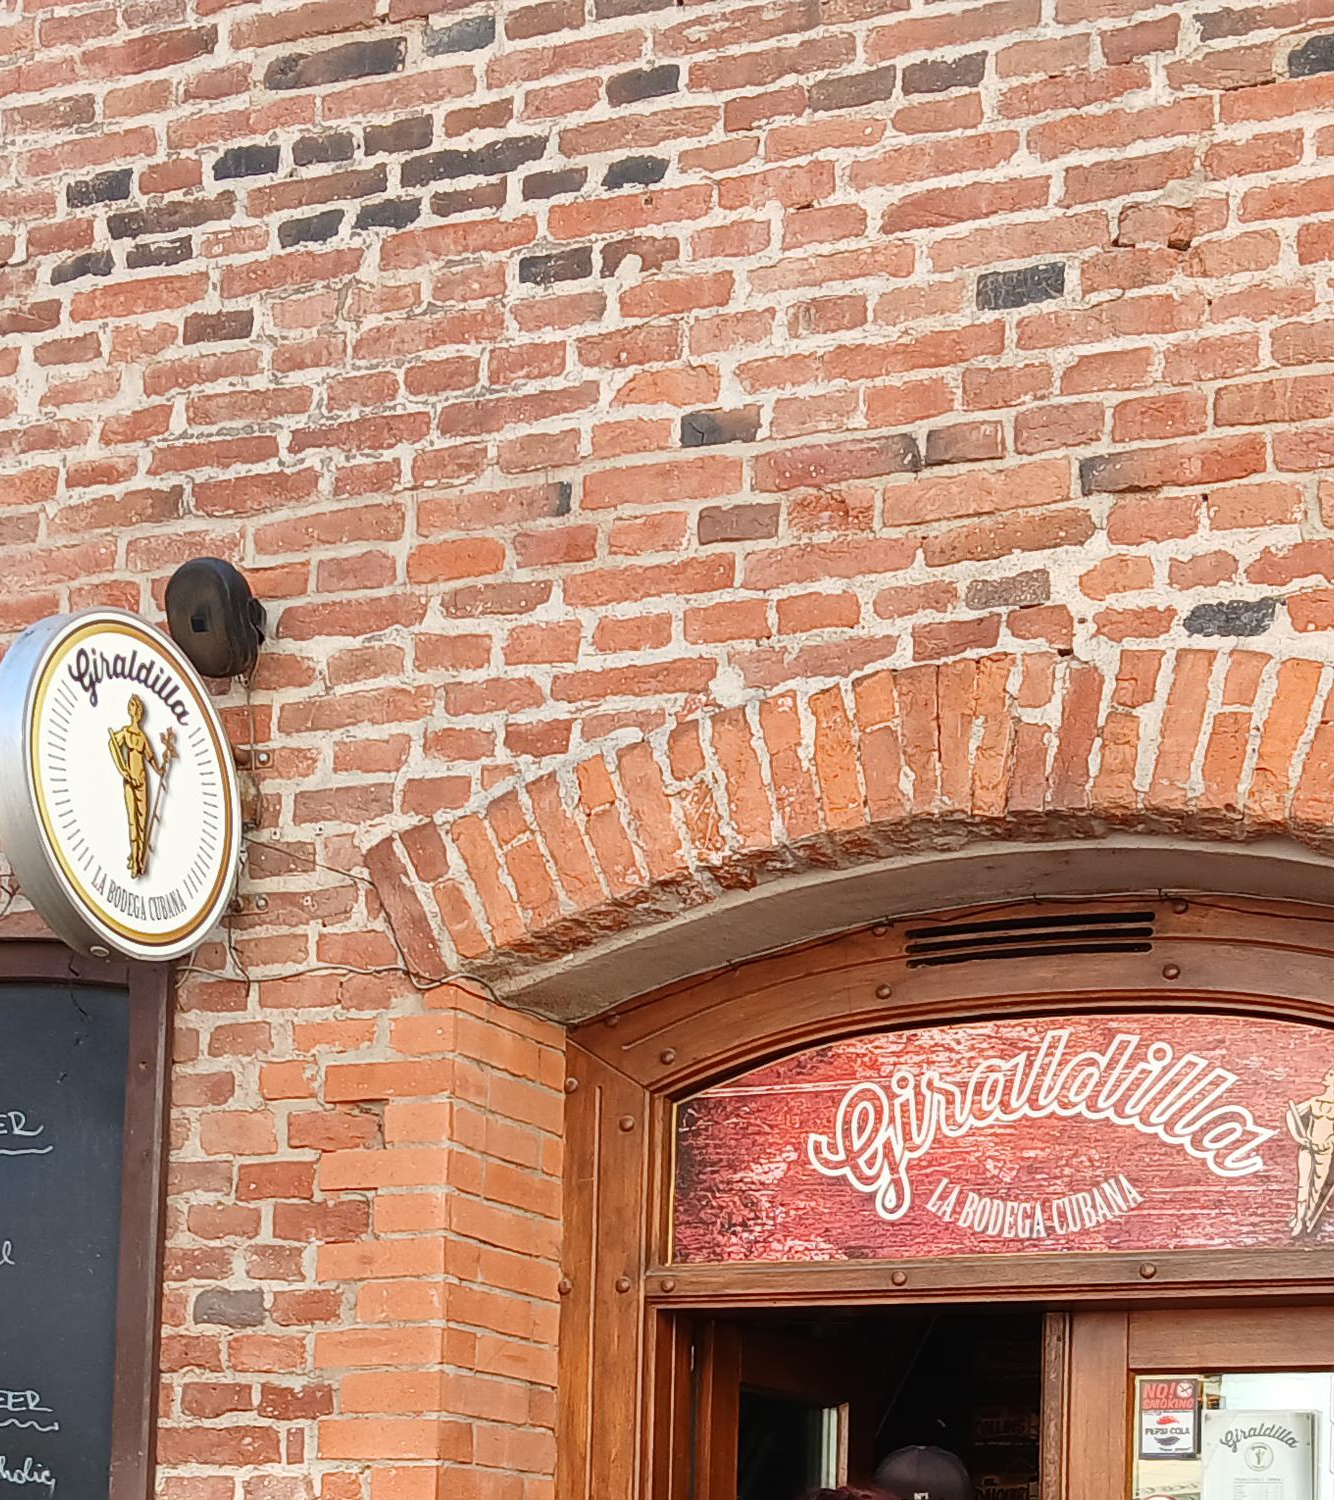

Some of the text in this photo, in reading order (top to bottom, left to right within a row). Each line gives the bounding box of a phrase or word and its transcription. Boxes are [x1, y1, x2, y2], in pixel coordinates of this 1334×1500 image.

[67, 648, 189, 726] Giraldilla
[91, 865, 187, 921] LA BODEGA CUBANA
[807, 1028, 1278, 1221] Giraldilla
[925, 1173, 1145, 1238] LA BODEGA CUBANA
[1142, 1398, 1194, 1409] SMOKING
[1220, 1423, 1300, 1453] Giraldilla
